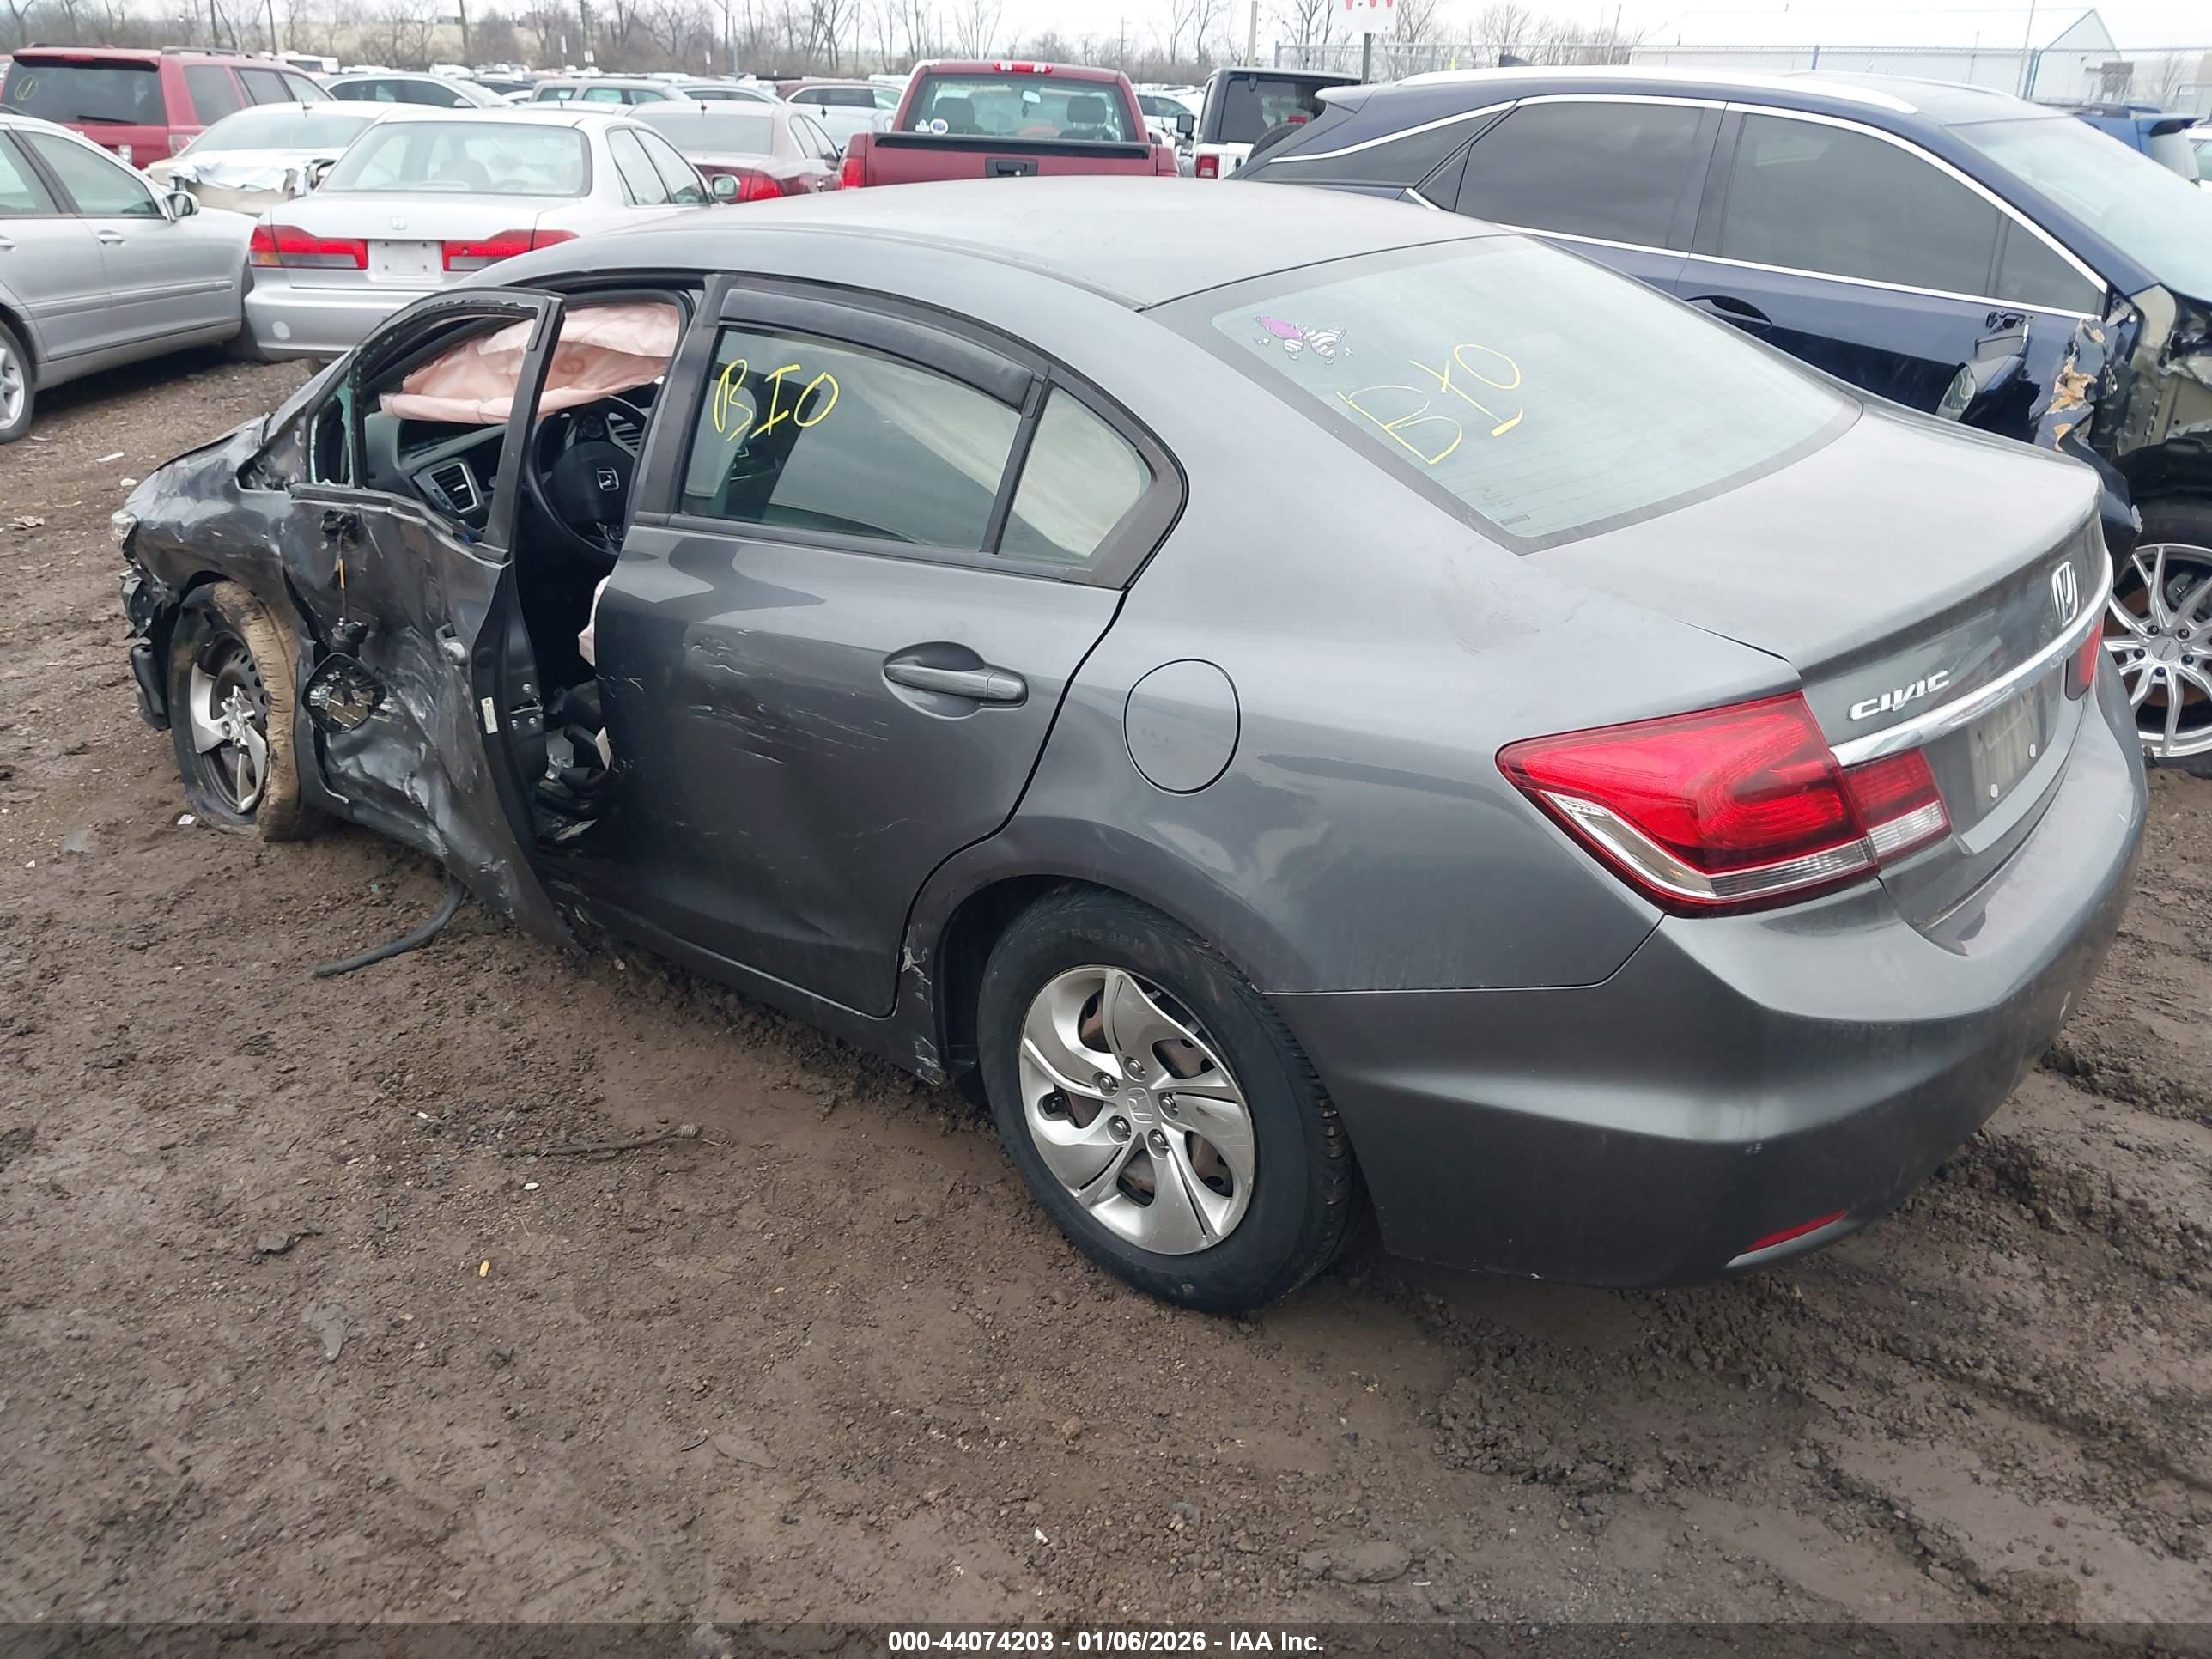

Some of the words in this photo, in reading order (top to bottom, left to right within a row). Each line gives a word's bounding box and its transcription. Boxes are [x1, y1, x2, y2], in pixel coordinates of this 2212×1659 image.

[714, 357, 839, 441] BIO
[1336, 343, 1524, 465] BIO
[1849, 670, 1950, 721] CIVIC
